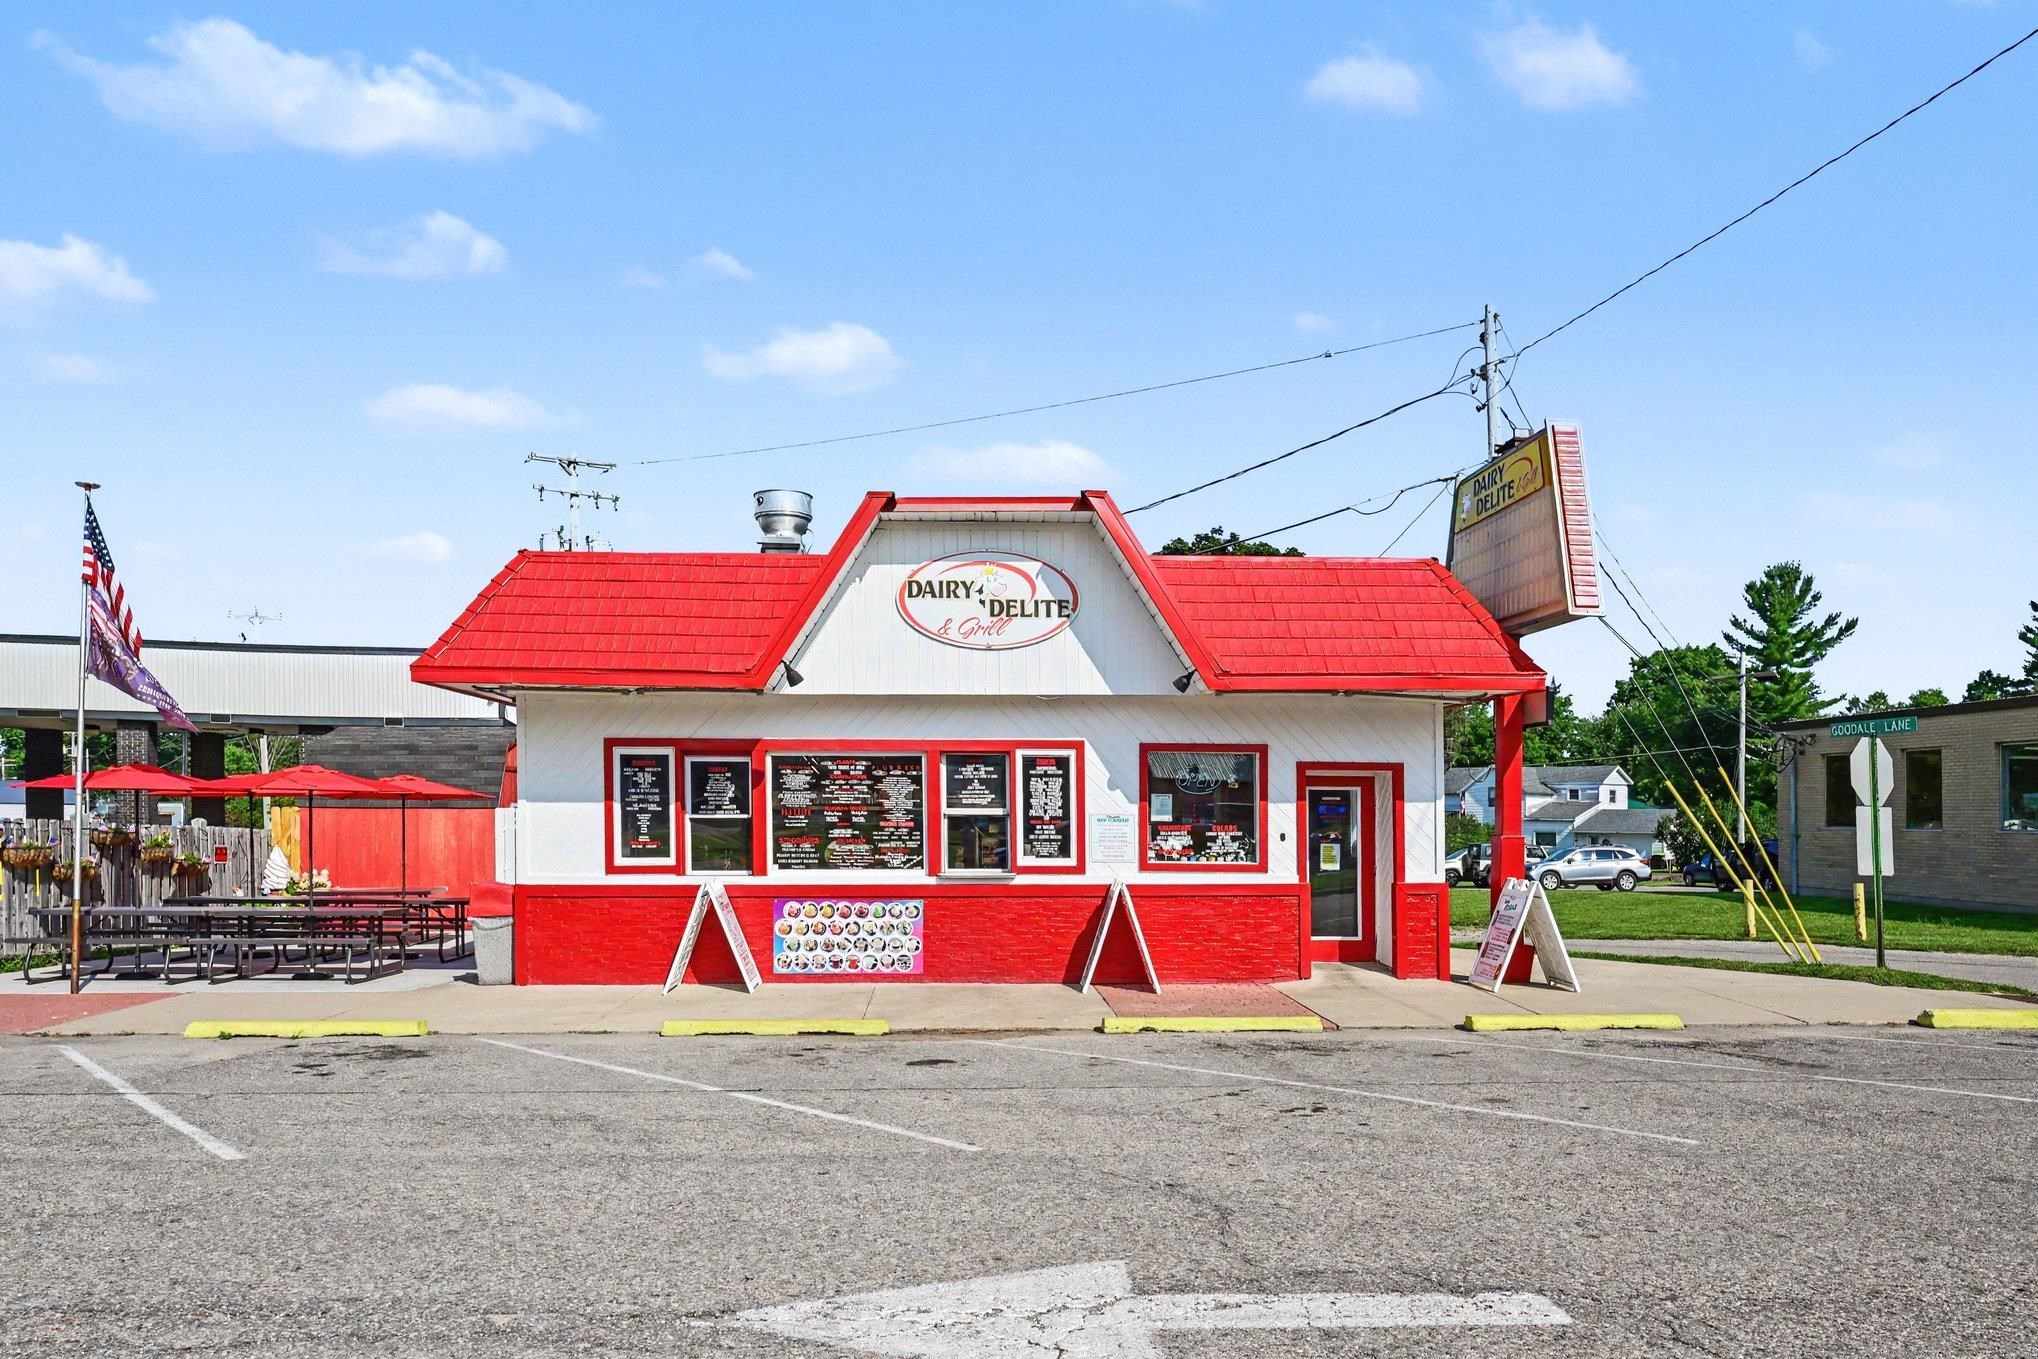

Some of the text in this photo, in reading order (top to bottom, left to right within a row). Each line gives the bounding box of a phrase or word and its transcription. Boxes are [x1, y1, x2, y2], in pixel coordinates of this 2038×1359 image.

[1473, 463, 1505, 497] DAIRY
[1476, 480, 1515, 516] DELITE
[907, 579, 975, 599] DAIRY
[989, 598, 1071, 619] DELITE
[937, 616, 1013, 640] & Grill
[1831, 718, 1912, 736] GOODALE LANE
[1178, 770, 1216, 787] OPEN
